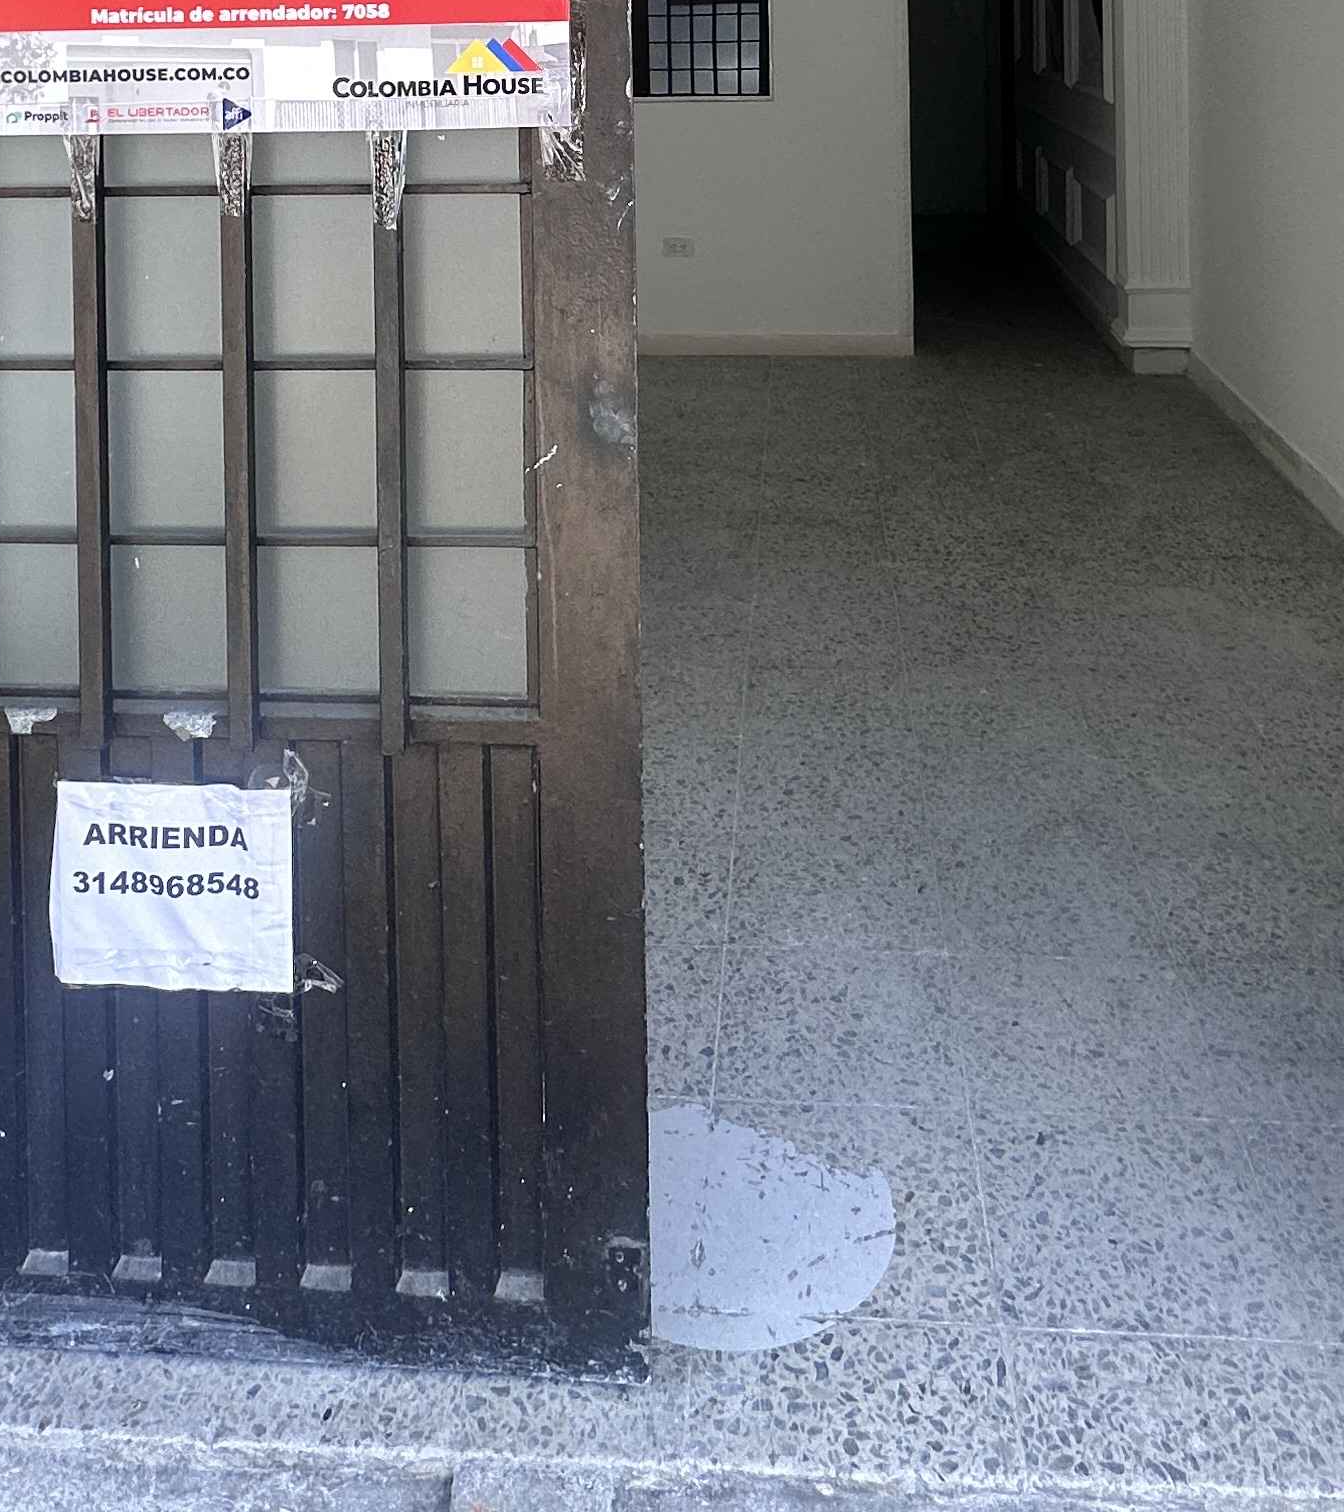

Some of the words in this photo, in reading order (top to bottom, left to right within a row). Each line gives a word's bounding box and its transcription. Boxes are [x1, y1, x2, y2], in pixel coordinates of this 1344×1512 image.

[90, 6, 185, 24] Matrícula
[189, 5, 214, 23] de
[218, 4, 338, 23] arrendador:
[341, 2, 391, 20] 7058
[332, 76, 458, 99] COLOMBIA
[462, 74, 544, 96] HOUSE
[107, 107, 124, 118] EL
[127, 106, 211, 118] LIBERTADOR
[83, 823, 249, 851] ARRIENDA
[72, 871, 260, 900] 3148968548
